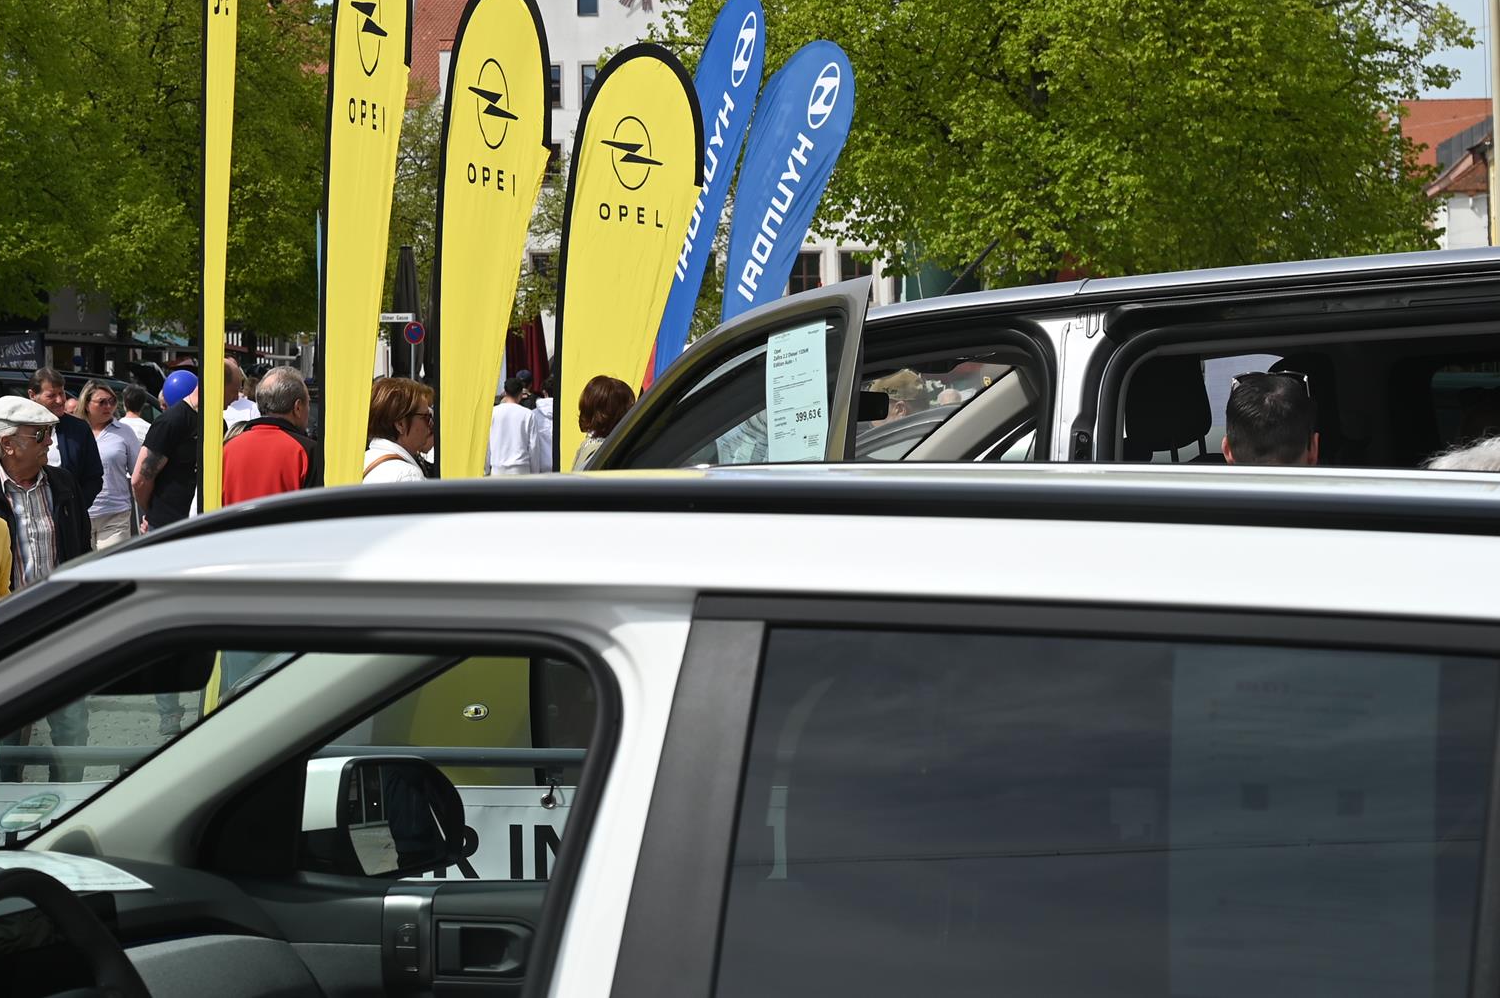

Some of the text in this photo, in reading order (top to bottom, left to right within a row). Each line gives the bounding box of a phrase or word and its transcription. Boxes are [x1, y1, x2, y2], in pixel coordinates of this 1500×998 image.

[599, 202, 664, 228] OPEL
[795, 409, 817, 422] 399,63
[817, 408, 822, 418] €
